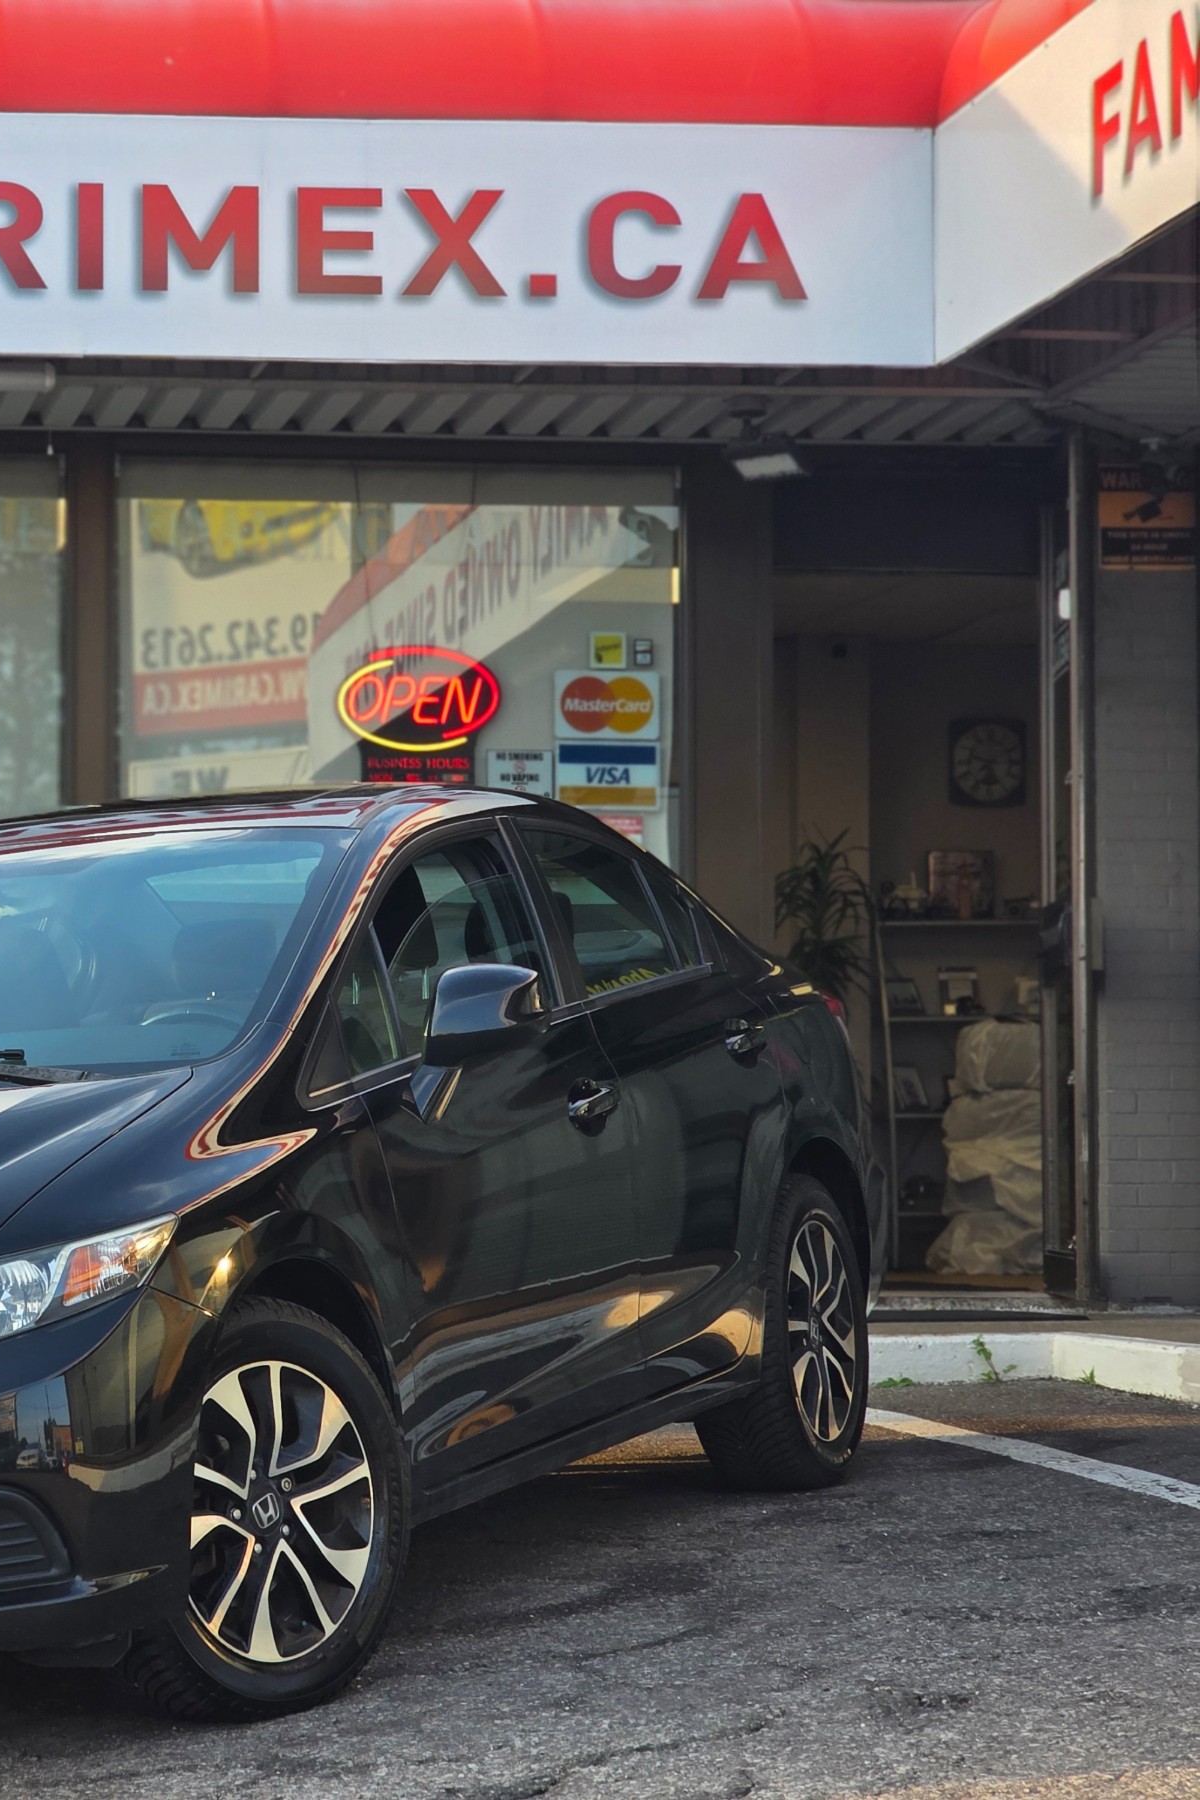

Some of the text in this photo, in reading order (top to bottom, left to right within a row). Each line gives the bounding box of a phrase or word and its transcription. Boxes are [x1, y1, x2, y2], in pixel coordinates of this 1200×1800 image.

[349, 674, 484, 725] OPEN
[563, 697, 651, 713] MasterCard
[367, 757, 470, 769] BUSINESS HOURS
[495, 752, 507, 761] NO
[500, 773, 512, 782] NO
[585, 766, 631, 785] VISA
